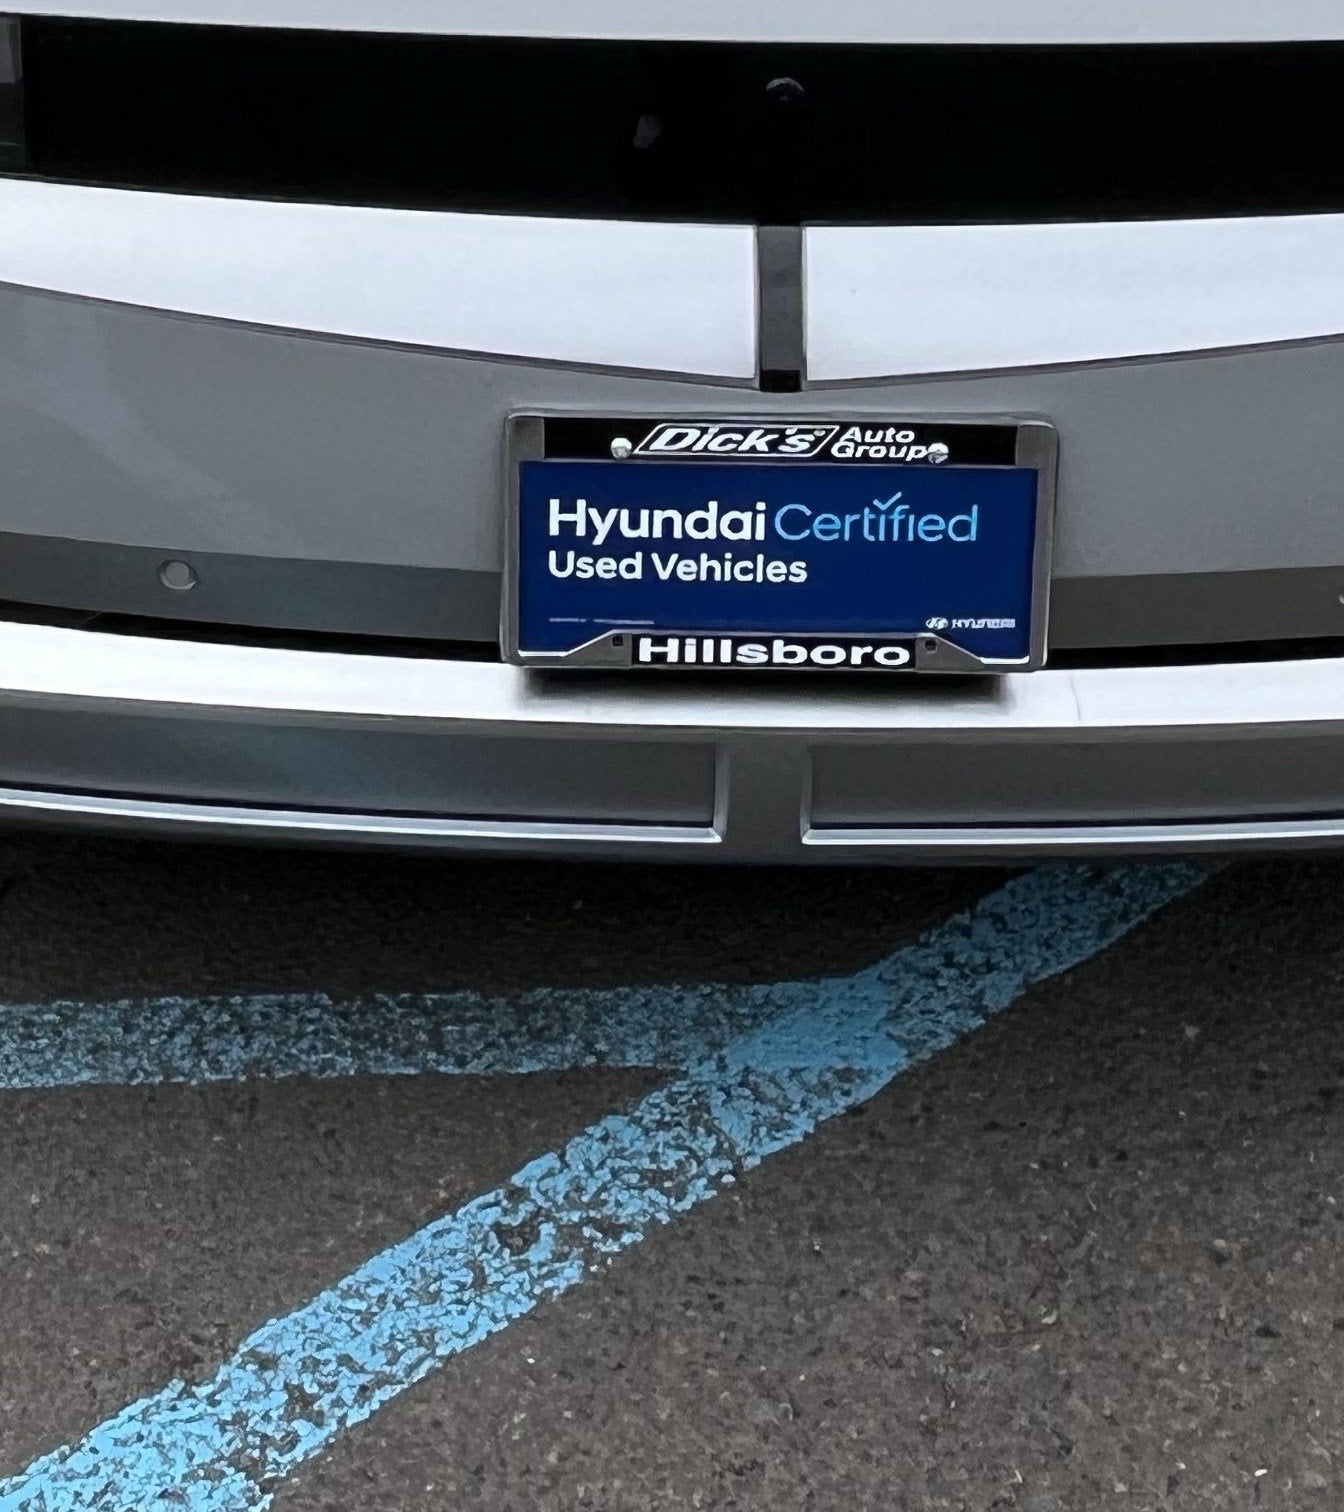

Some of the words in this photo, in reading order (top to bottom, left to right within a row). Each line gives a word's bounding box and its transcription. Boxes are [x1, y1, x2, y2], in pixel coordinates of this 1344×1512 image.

[839, 426, 915, 444] Auto
[830, 441, 930, 462] Group
[548, 498, 766, 547] Hyundai
[774, 492, 978, 543] Certified
[548, 550, 642, 580] Used
[651, 550, 808, 584] Vehicles
[638, 636, 911, 667] Hillsboro
